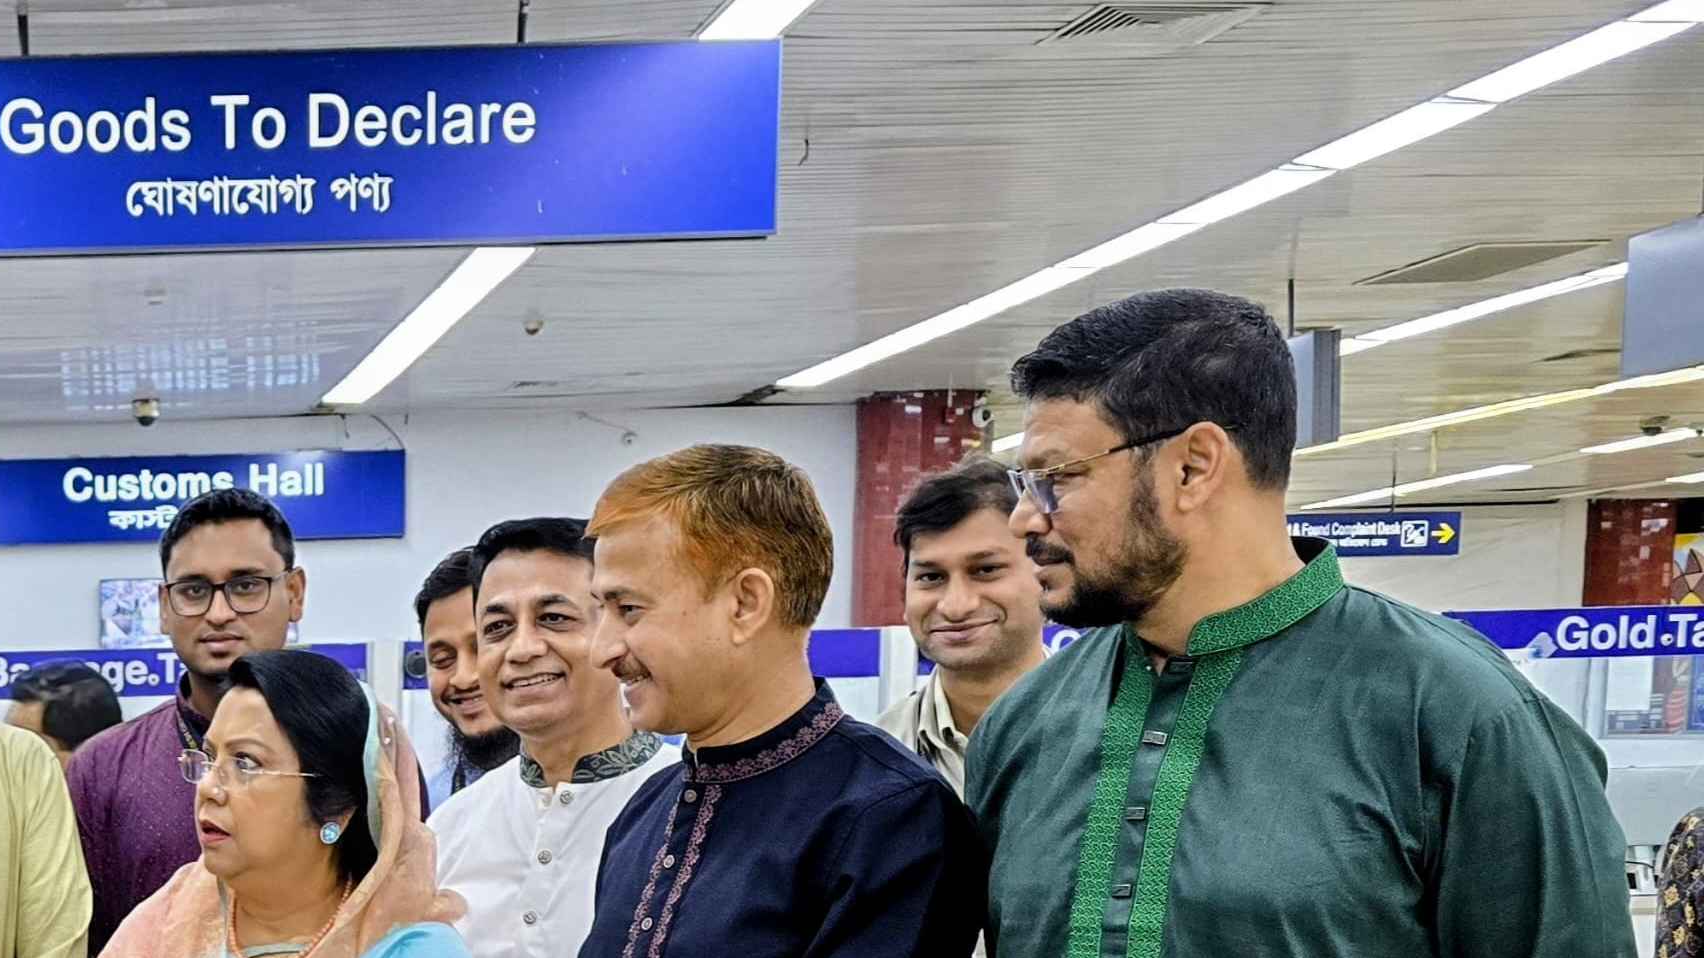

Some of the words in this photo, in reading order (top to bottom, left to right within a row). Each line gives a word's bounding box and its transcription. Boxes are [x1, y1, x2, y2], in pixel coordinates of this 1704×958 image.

[210, 94, 286, 150] To
[308, 91, 537, 149] Declare
[125, 173, 316, 217] ঘোষণাযোগ্য
[329, 172, 394, 213] পণ্য
[62, 466, 235, 502] Customs
[248, 462, 325, 497] Hall
[107, 504, 180, 530] কাস্ট
